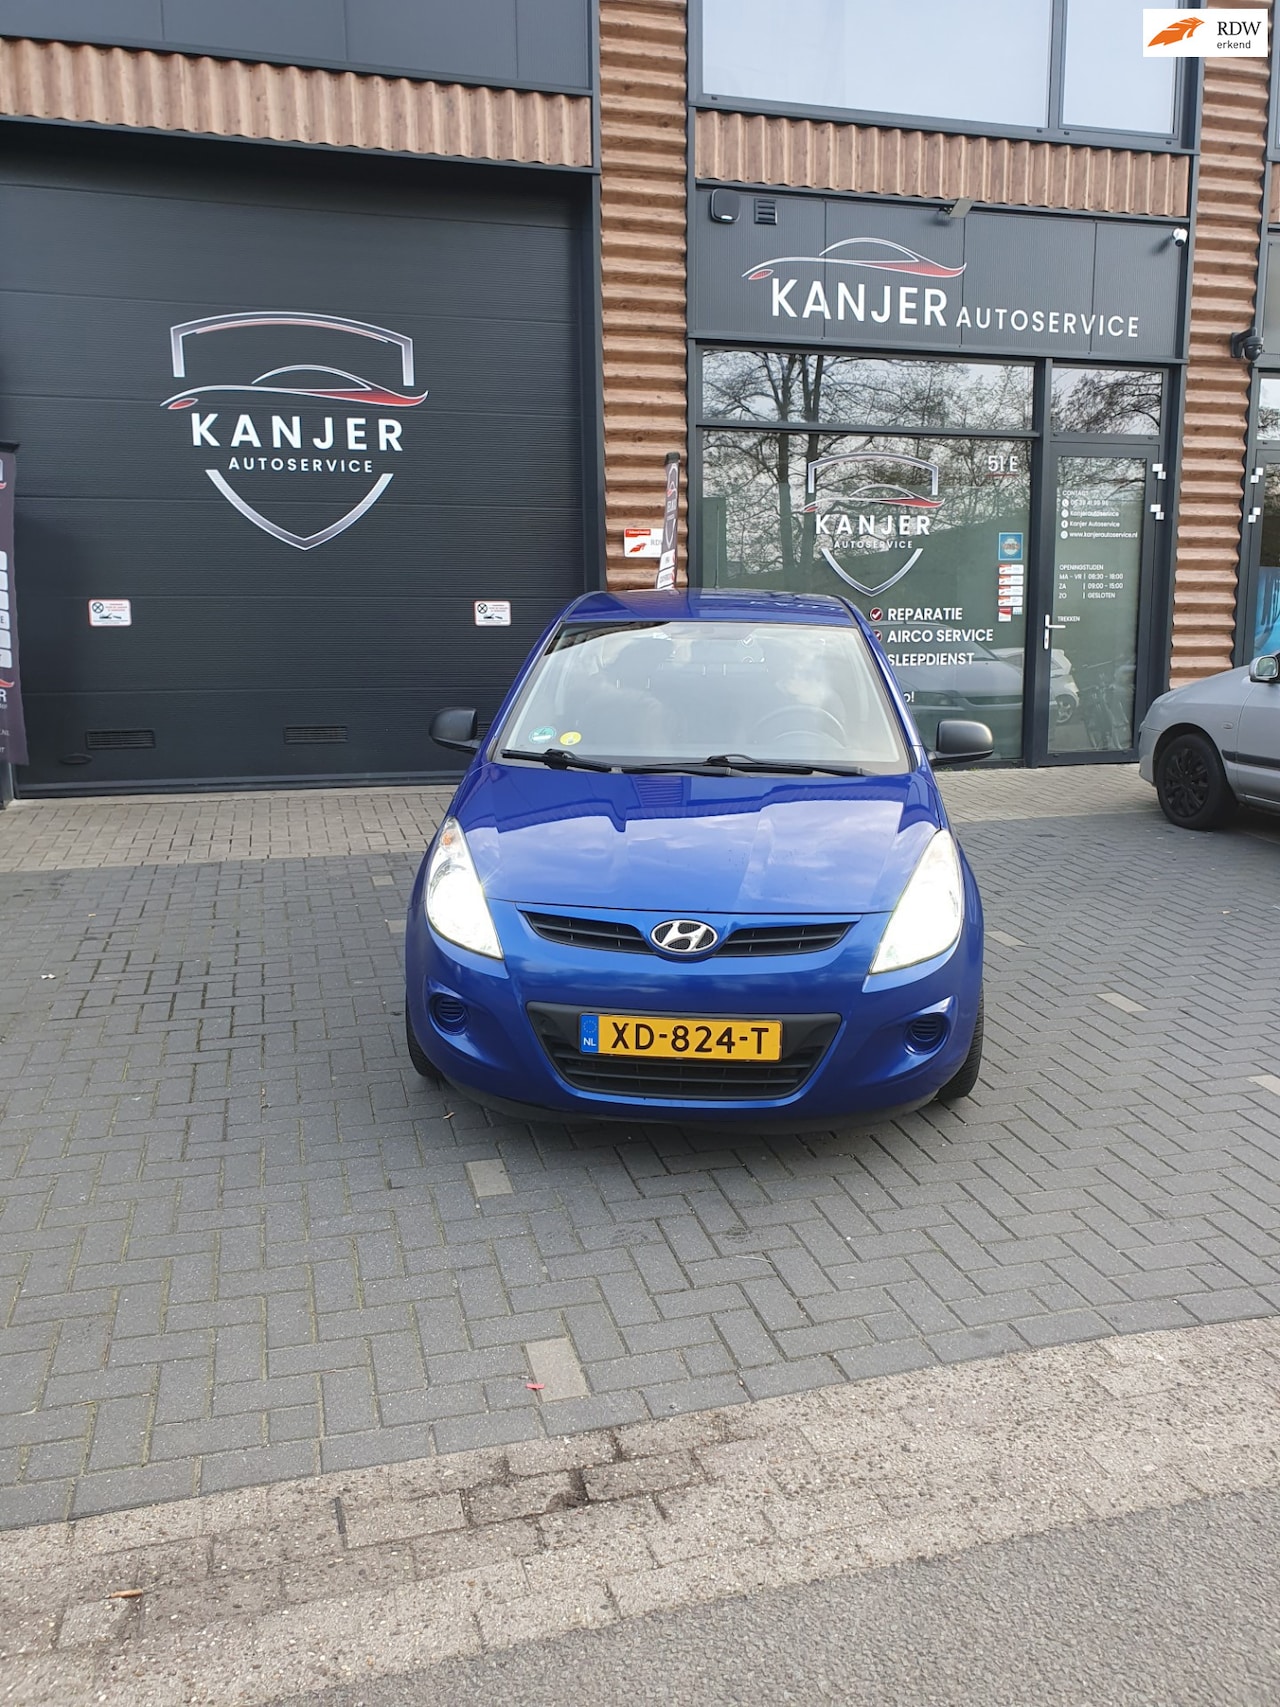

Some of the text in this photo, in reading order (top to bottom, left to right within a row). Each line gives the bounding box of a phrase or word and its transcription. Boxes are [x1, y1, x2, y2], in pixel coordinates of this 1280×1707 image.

[772, 277, 1139, 338] KANJER AUTOSERVICE
[191, 412, 403, 451] KANJER
[228, 457, 373, 473] AUTOSERVICE
[816, 514, 931, 536] KANJER
[1069, 531, 1138, 539] www.kanjerautoservice.nl
[834, 540, 913, 549] AUTOSERVICE
[887, 607, 963, 621] REPARATIE
[887, 628, 994, 643] AIRCO SERVICE
[887, 652, 975, 667] SLEEPDIENST
[583, 1037, 597, 1047] NL
[611, 1022, 769, 1054] XD-824-T
